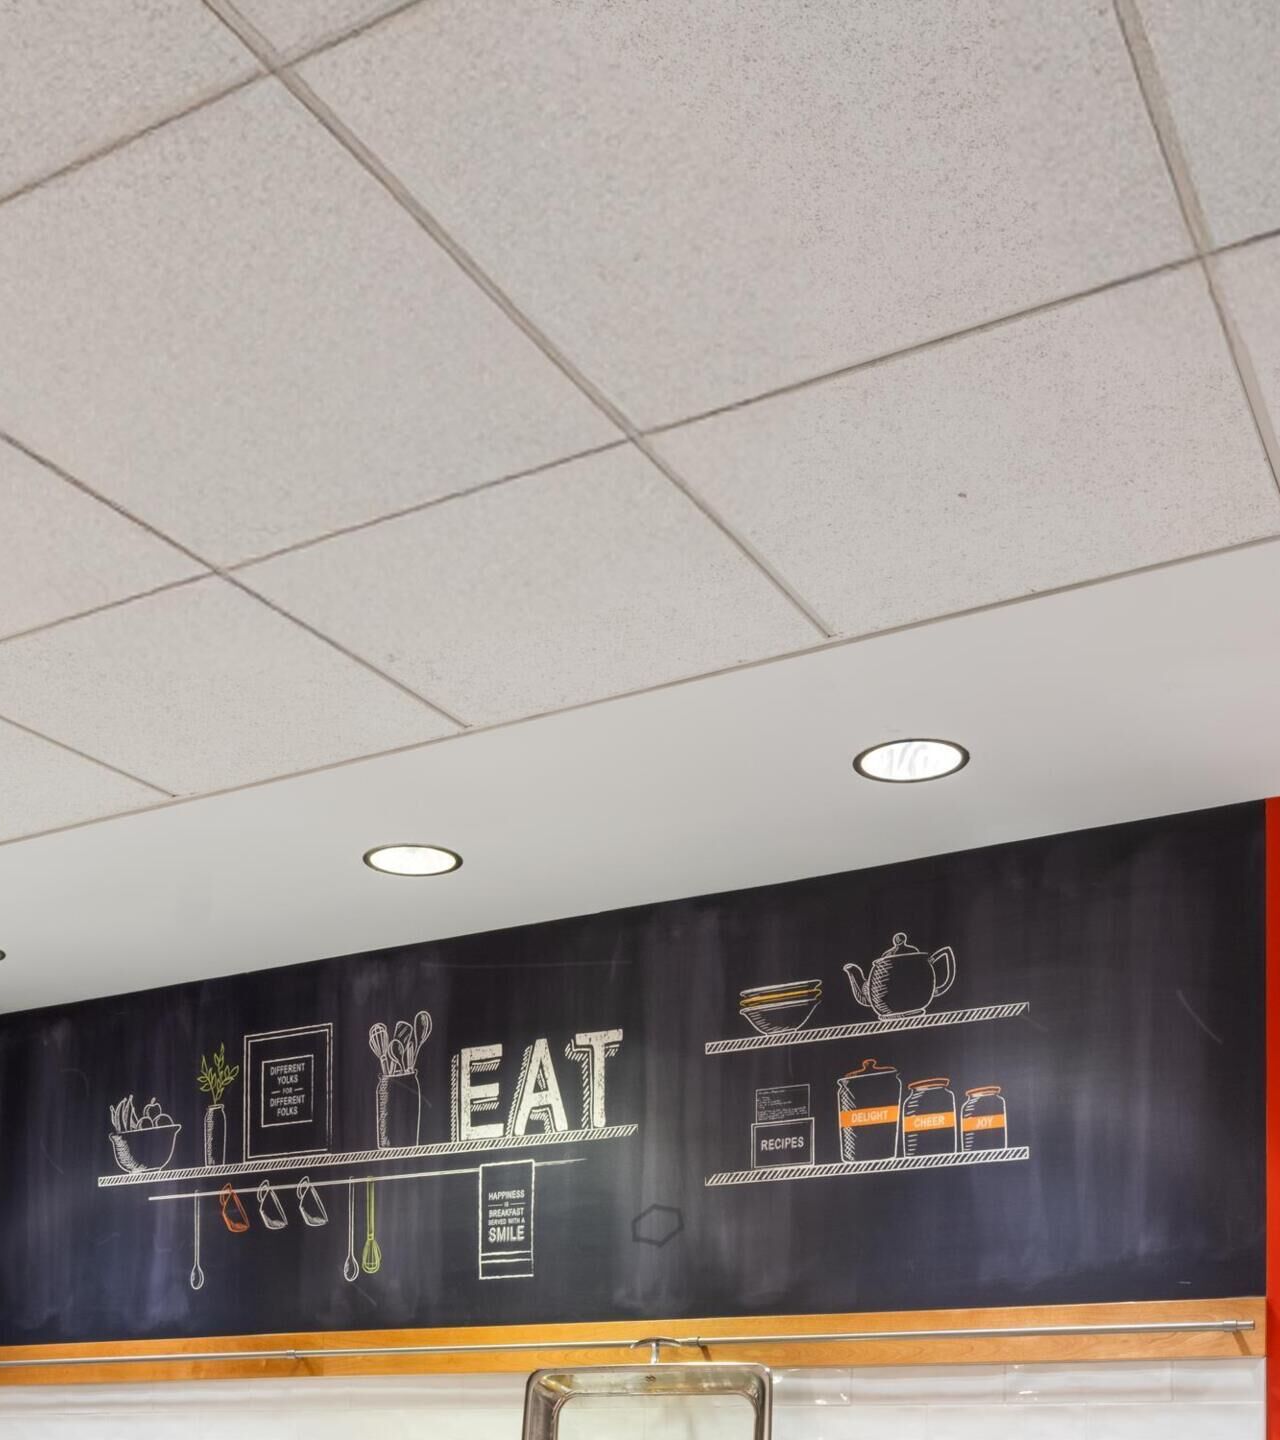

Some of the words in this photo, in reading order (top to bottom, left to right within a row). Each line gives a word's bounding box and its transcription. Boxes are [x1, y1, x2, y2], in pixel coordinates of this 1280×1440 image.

[270, 1063, 305, 1076] DIFFERENT
[277, 1074, 298, 1085] YOLKS
[451, 1028, 623, 1142] EAT
[270, 1094, 305, 1107] DIFFERENT
[277, 1106, 298, 1117] FOLKS
[851, 1110, 888, 1123] DELIGHT
[914, 1115, 945, 1127] CHEER
[976, 1117, 993, 1127] JOY
[761, 1136, 804, 1151] RECIPES
[488, 1189, 525, 1201] HAPPINESS
[488, 1207, 524, 1218] BREAKFAST
[488, 1225, 525, 1243] SMILE
